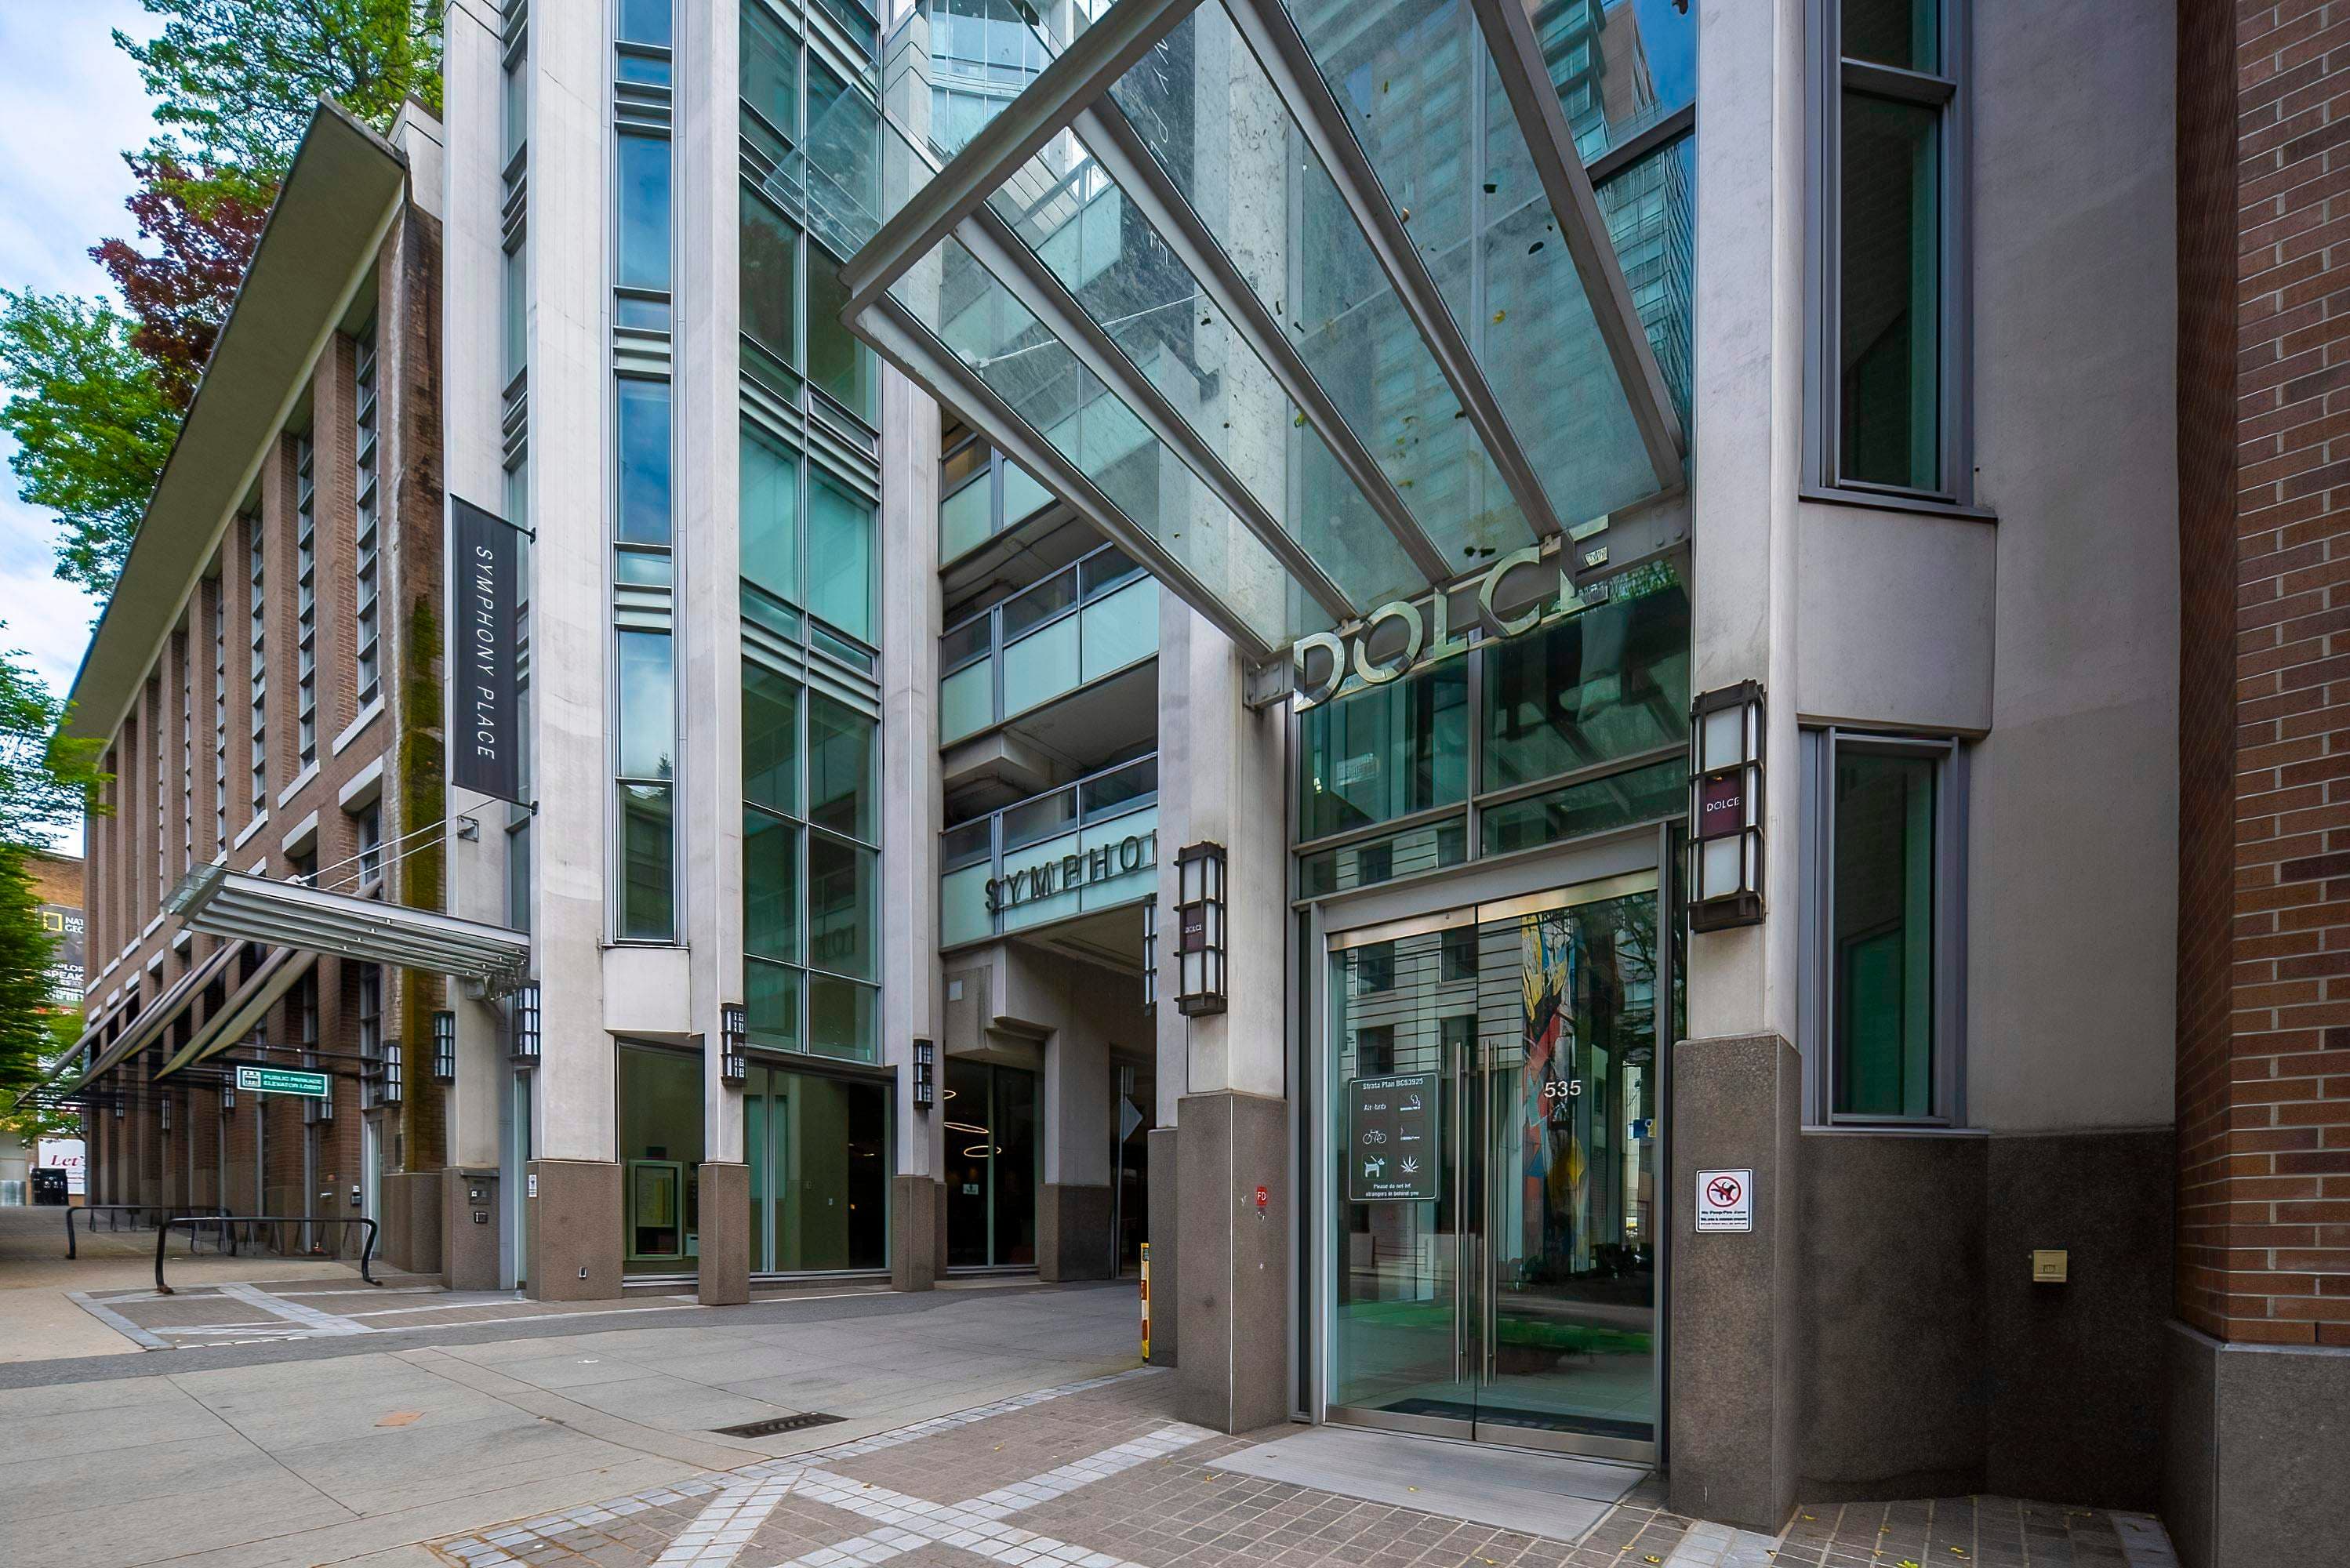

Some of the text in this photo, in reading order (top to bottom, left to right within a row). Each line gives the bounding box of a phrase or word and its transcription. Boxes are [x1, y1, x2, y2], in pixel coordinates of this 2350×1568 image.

[1293, 514, 1609, 713] DOLCE
[476, 546, 495, 760] SYMPHONY PLACE
[1706, 797, 1740, 812] DOLCE
[1544, 1080, 1582, 1098] 535
[1257, 1191, 1266, 1201] FD
